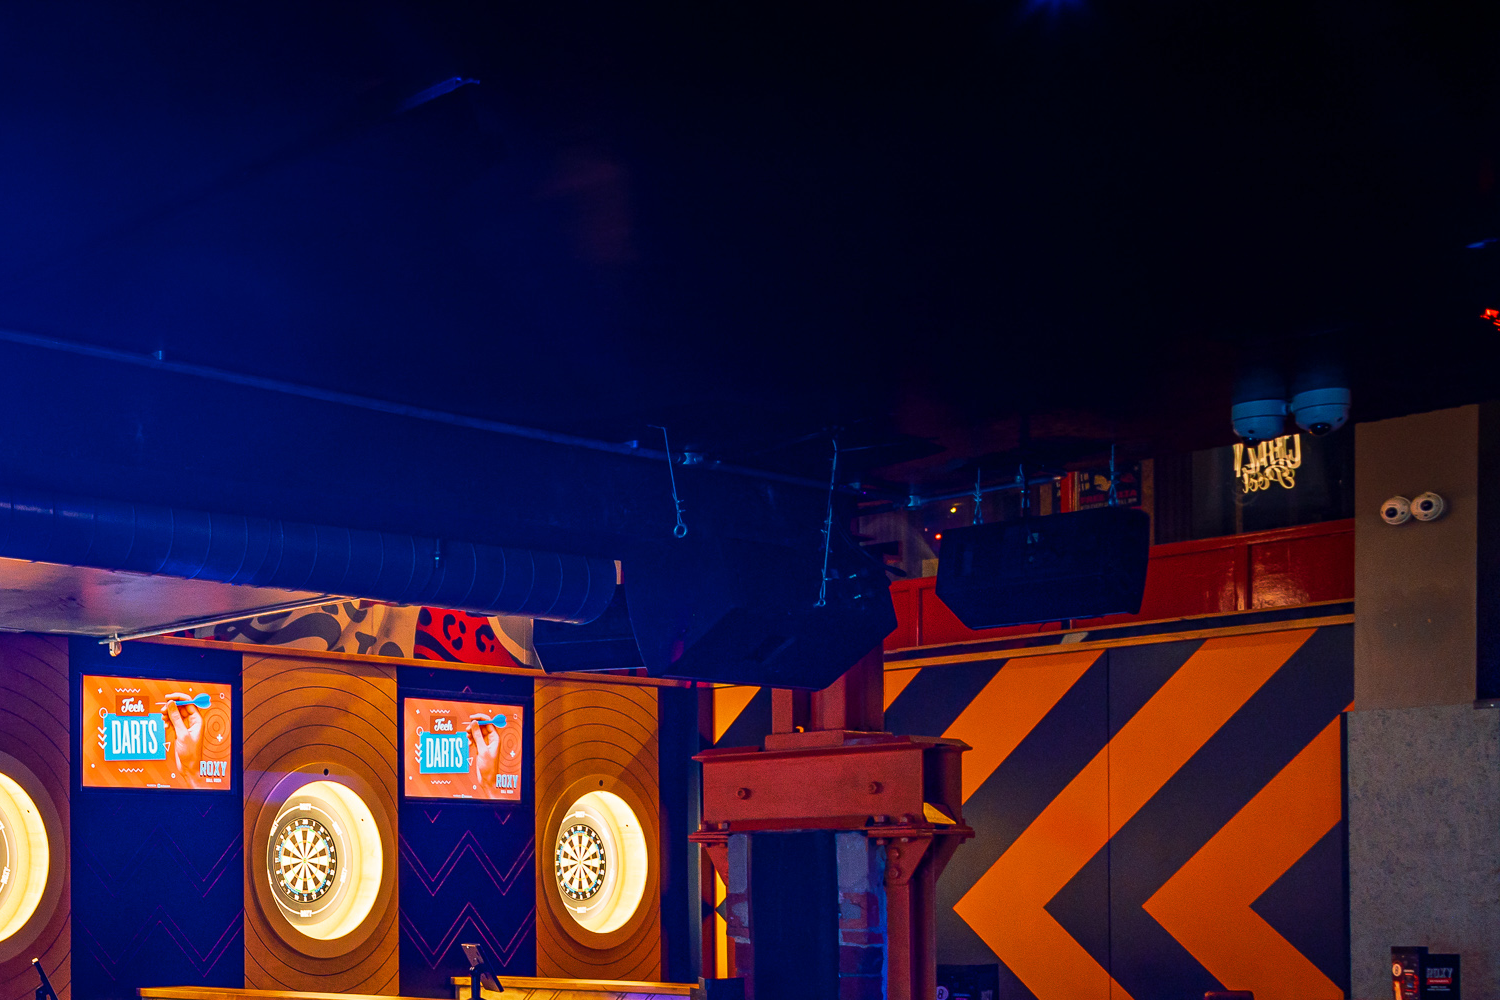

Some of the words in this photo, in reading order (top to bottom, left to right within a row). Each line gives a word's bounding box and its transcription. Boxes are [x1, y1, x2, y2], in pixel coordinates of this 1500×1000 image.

[121, 697, 145, 712] Tech
[434, 718, 453, 731] Tech
[111, 720, 158, 755] DARTS
[426, 738, 463, 768] DARTS
[200, 761, 227, 778] ROXY
[496, 774, 518, 789] ROXY
[938, 989, 944, 999] 8
